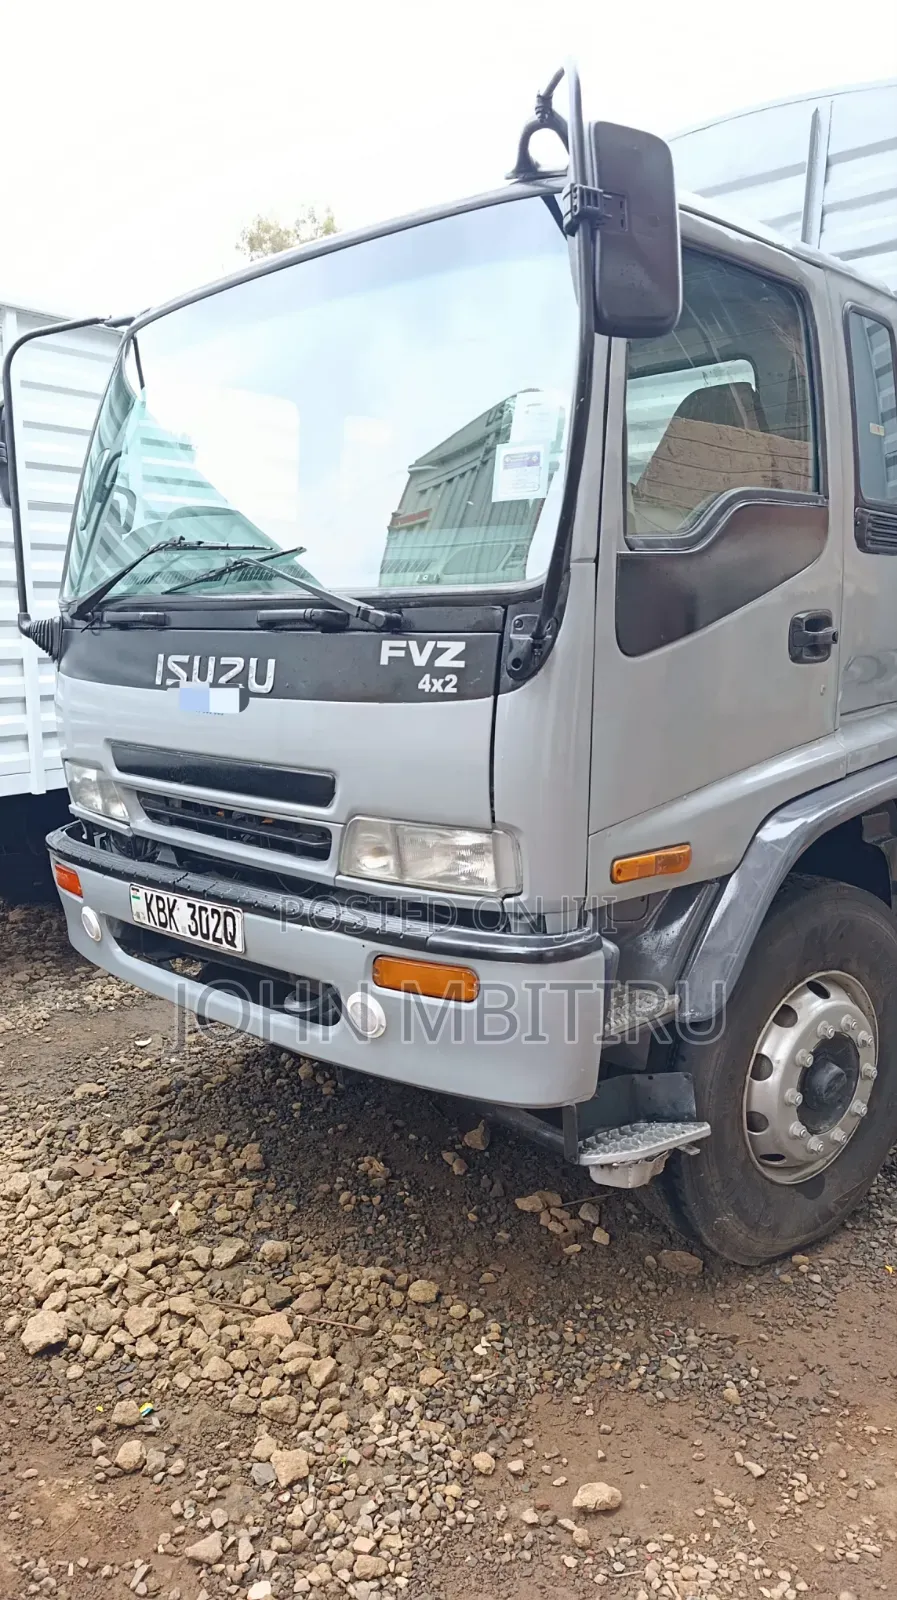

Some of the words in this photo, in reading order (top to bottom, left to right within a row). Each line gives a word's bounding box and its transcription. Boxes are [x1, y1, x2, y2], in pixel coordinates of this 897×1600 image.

[380, 640, 466, 668] FVZ
[155, 653, 276, 694] ISUZU
[417, 673, 458, 693] 4x2
[144, 891, 179, 932] KBK
[187, 902, 237, 949] 302Q
